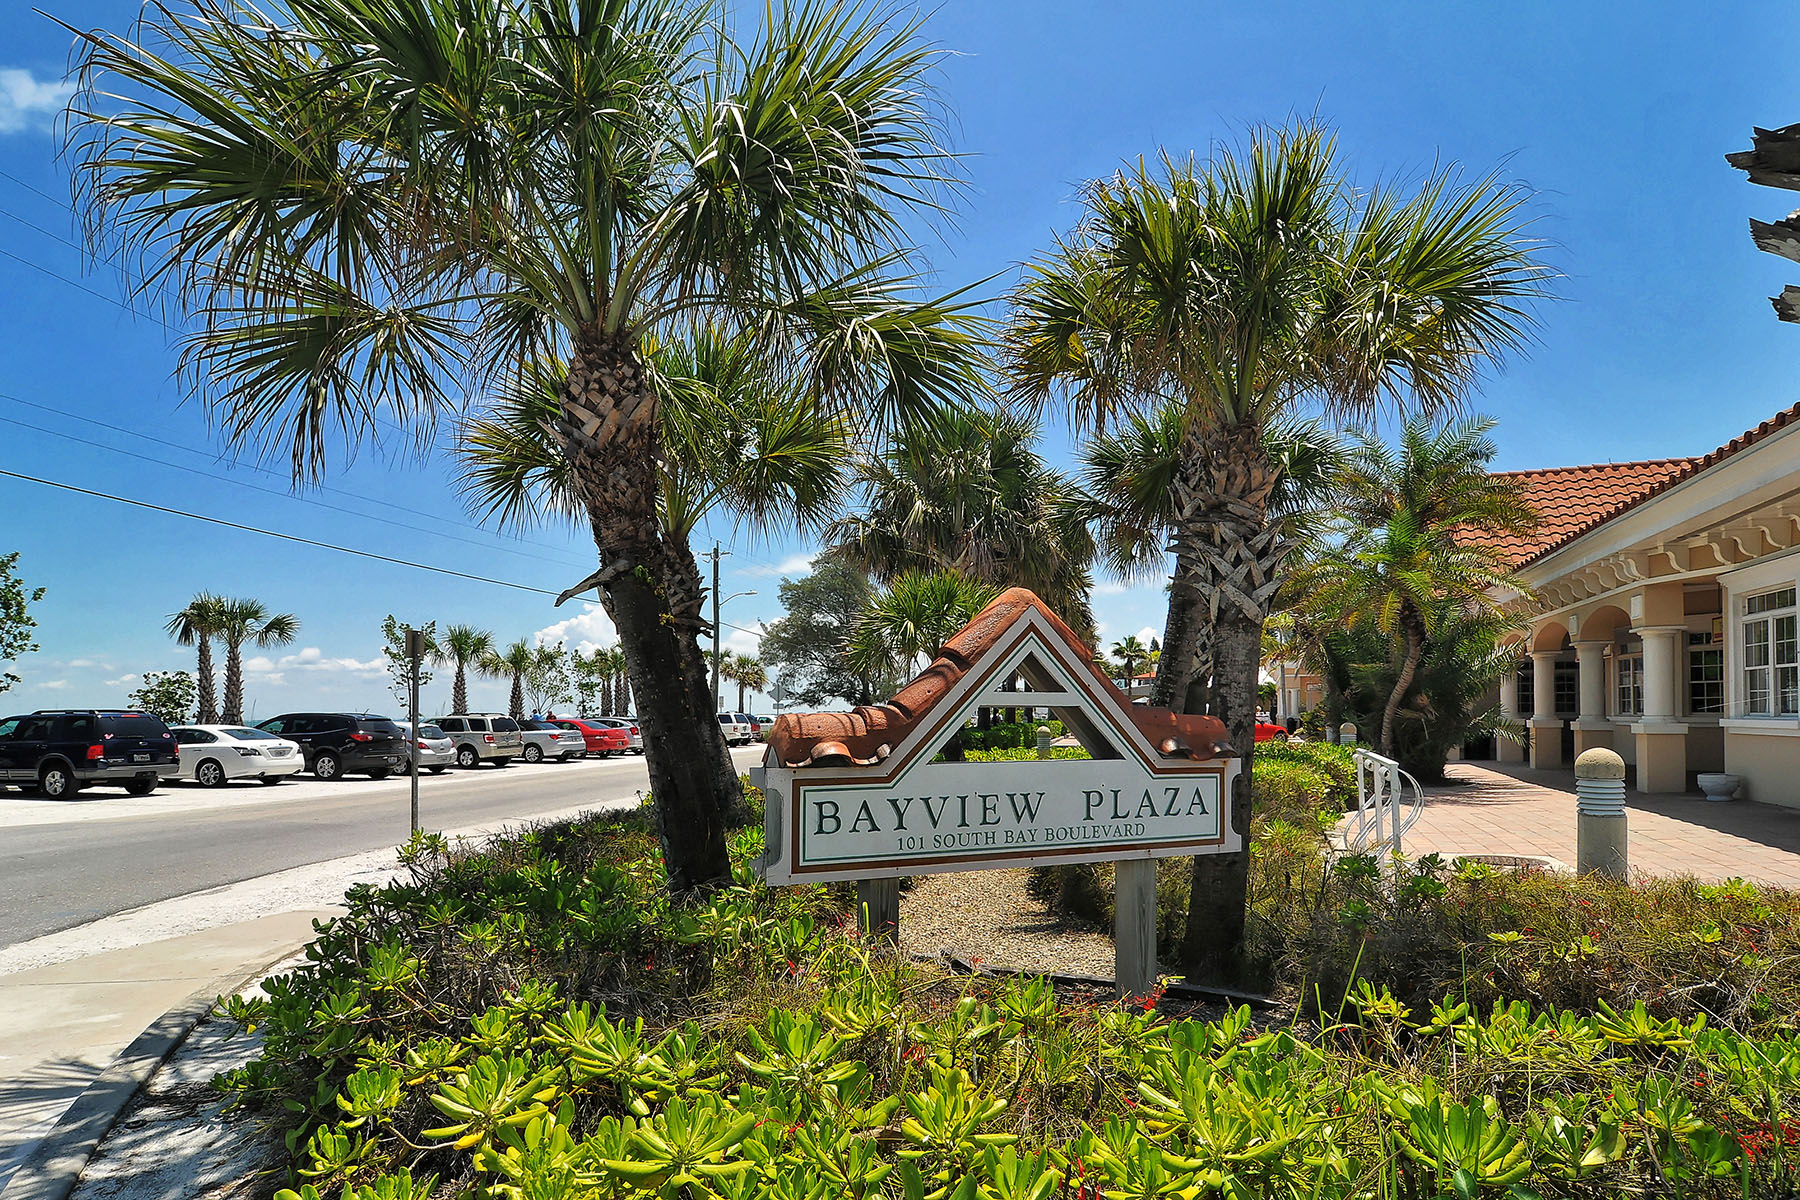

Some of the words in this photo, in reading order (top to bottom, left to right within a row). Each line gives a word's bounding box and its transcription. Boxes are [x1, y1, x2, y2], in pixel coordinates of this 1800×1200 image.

[812, 792, 1046, 836] BAYVIEW
[1081, 786, 1210, 821] PLAZA
[897, 836, 925, 851] 101
[932, 831, 997, 849] SOUTH
[1003, 828, 1039, 844] BAY
[1044, 823, 1146, 841] BOULEVARD
